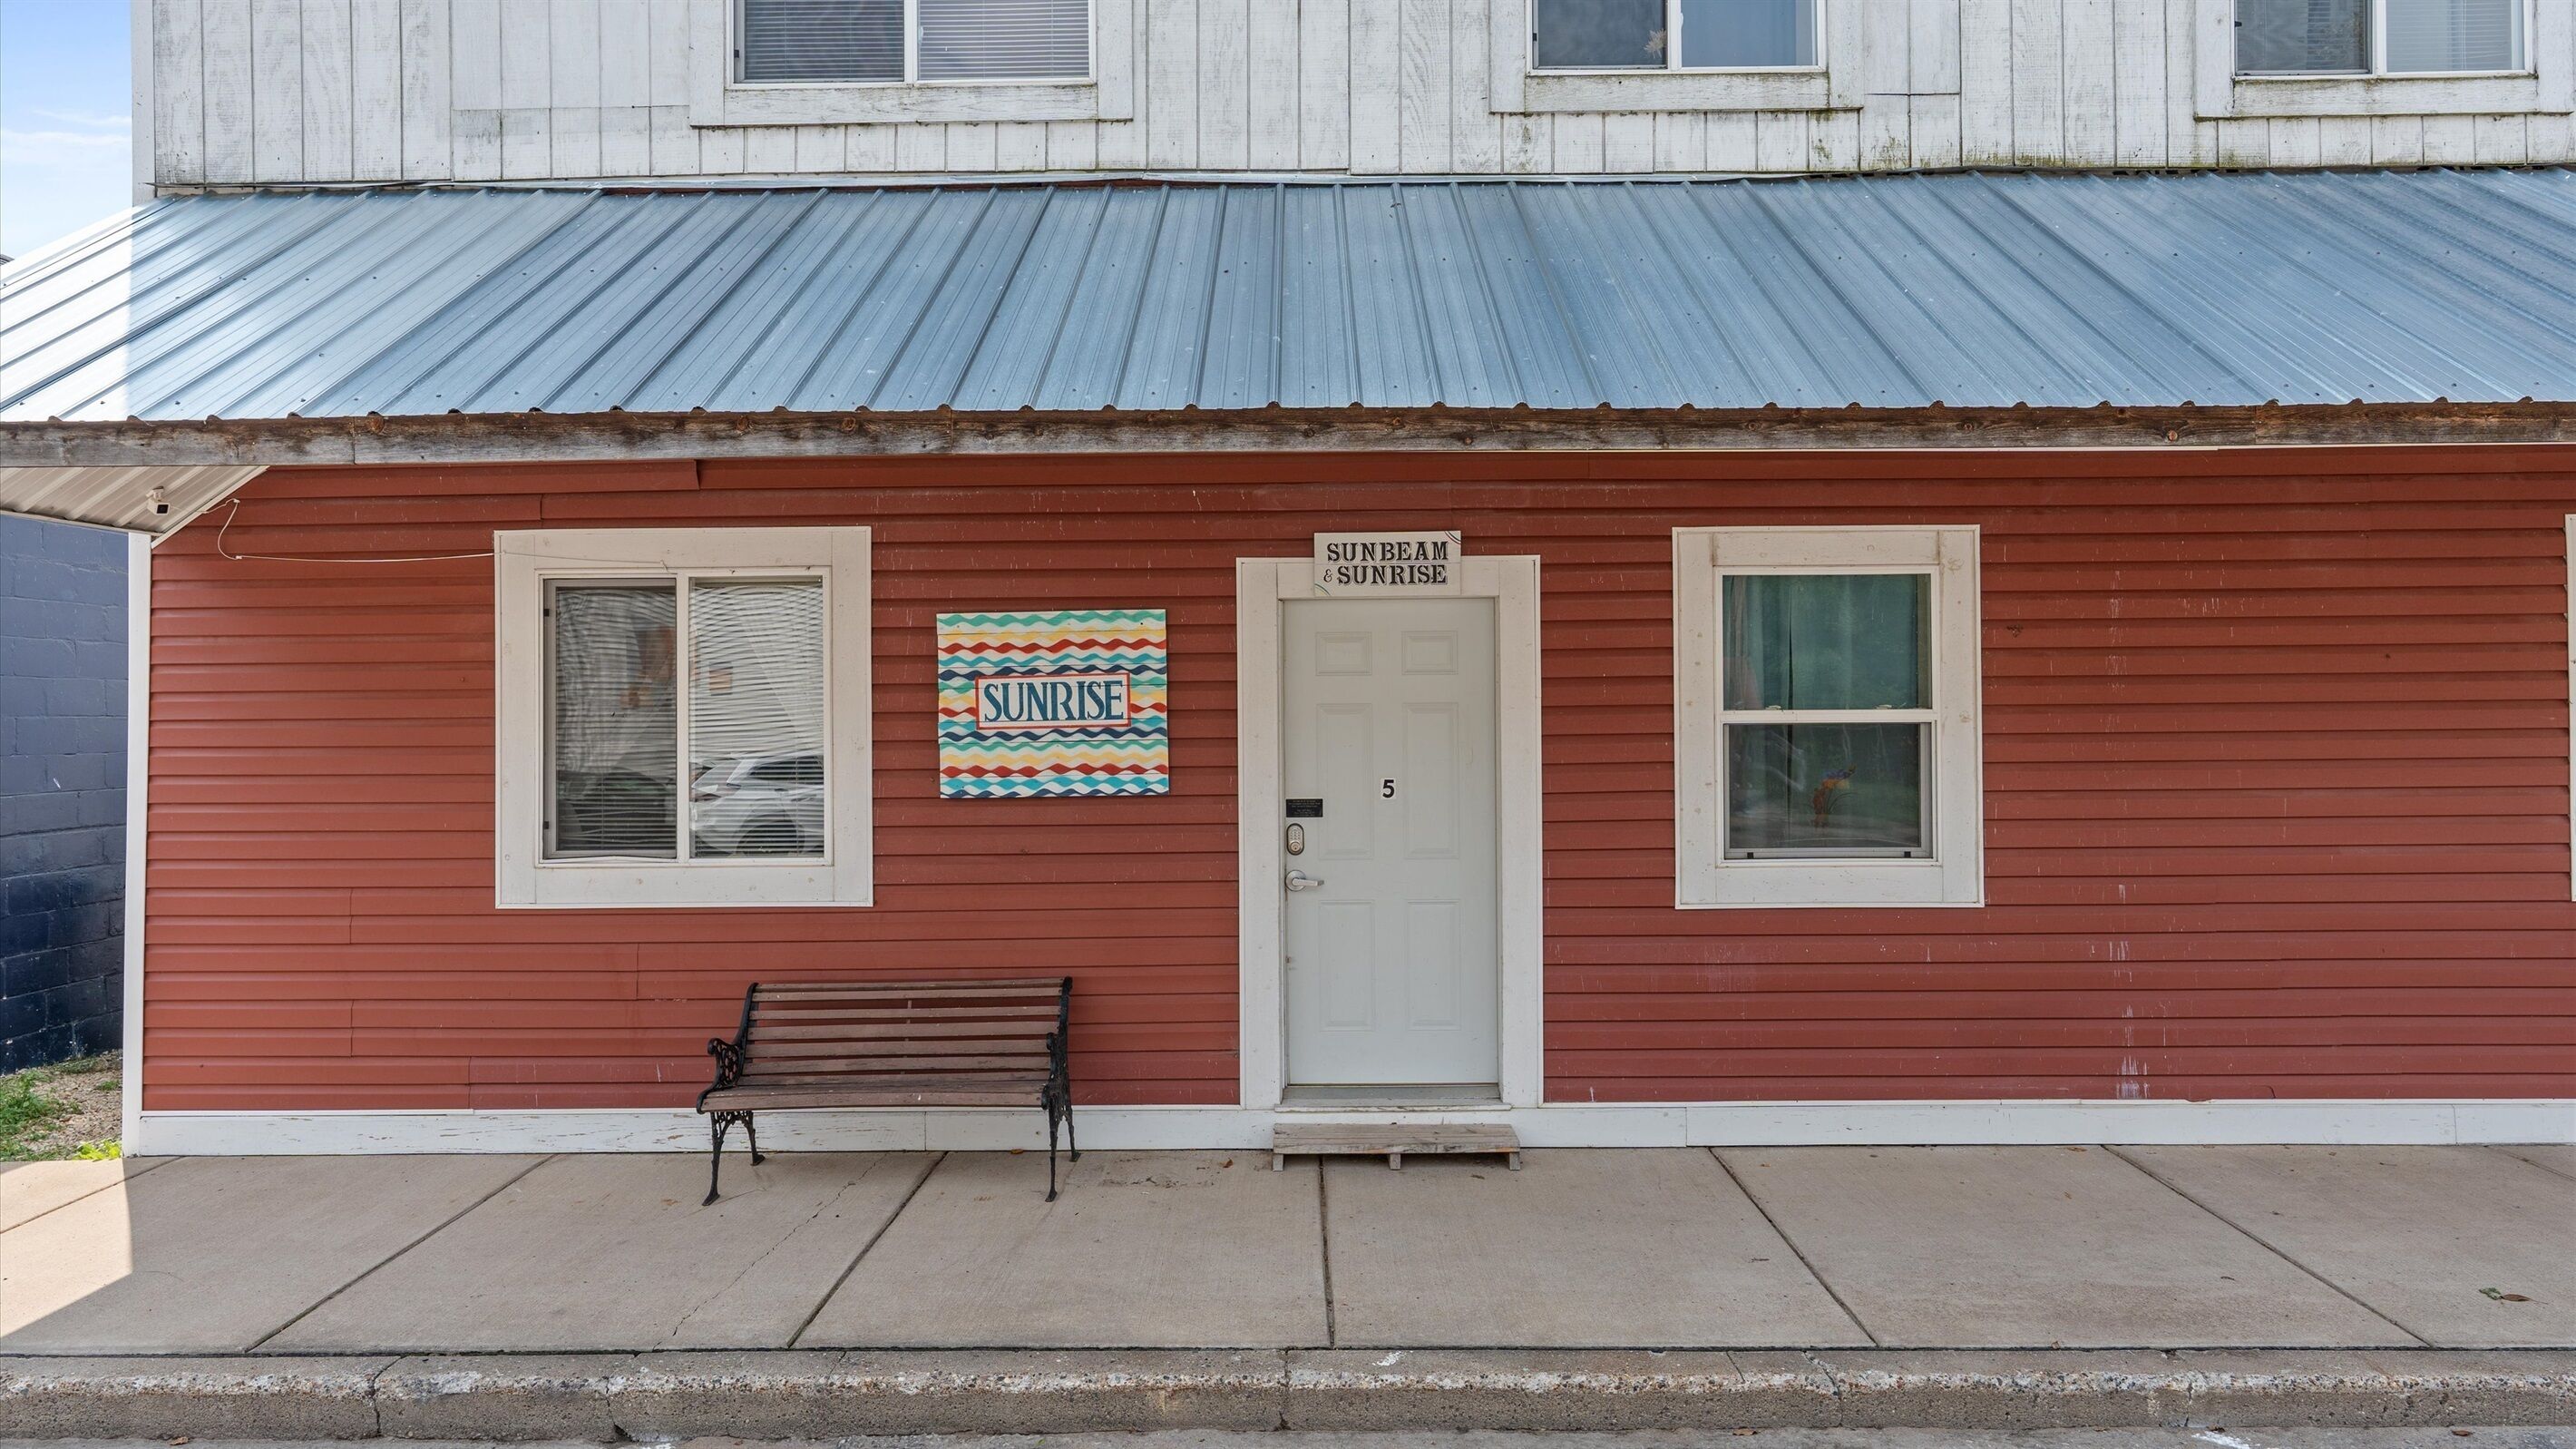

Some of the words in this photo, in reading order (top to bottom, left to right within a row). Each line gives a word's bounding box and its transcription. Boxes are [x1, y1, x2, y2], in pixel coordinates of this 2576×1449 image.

[1327, 541, 1449, 562] SUNBEAM
[1323, 569, 1333, 583] &
[1337, 564, 1448, 584] SUNRISE
[983, 680, 1125, 722] SUNRISE
[1382, 778, 1395, 798] 5
